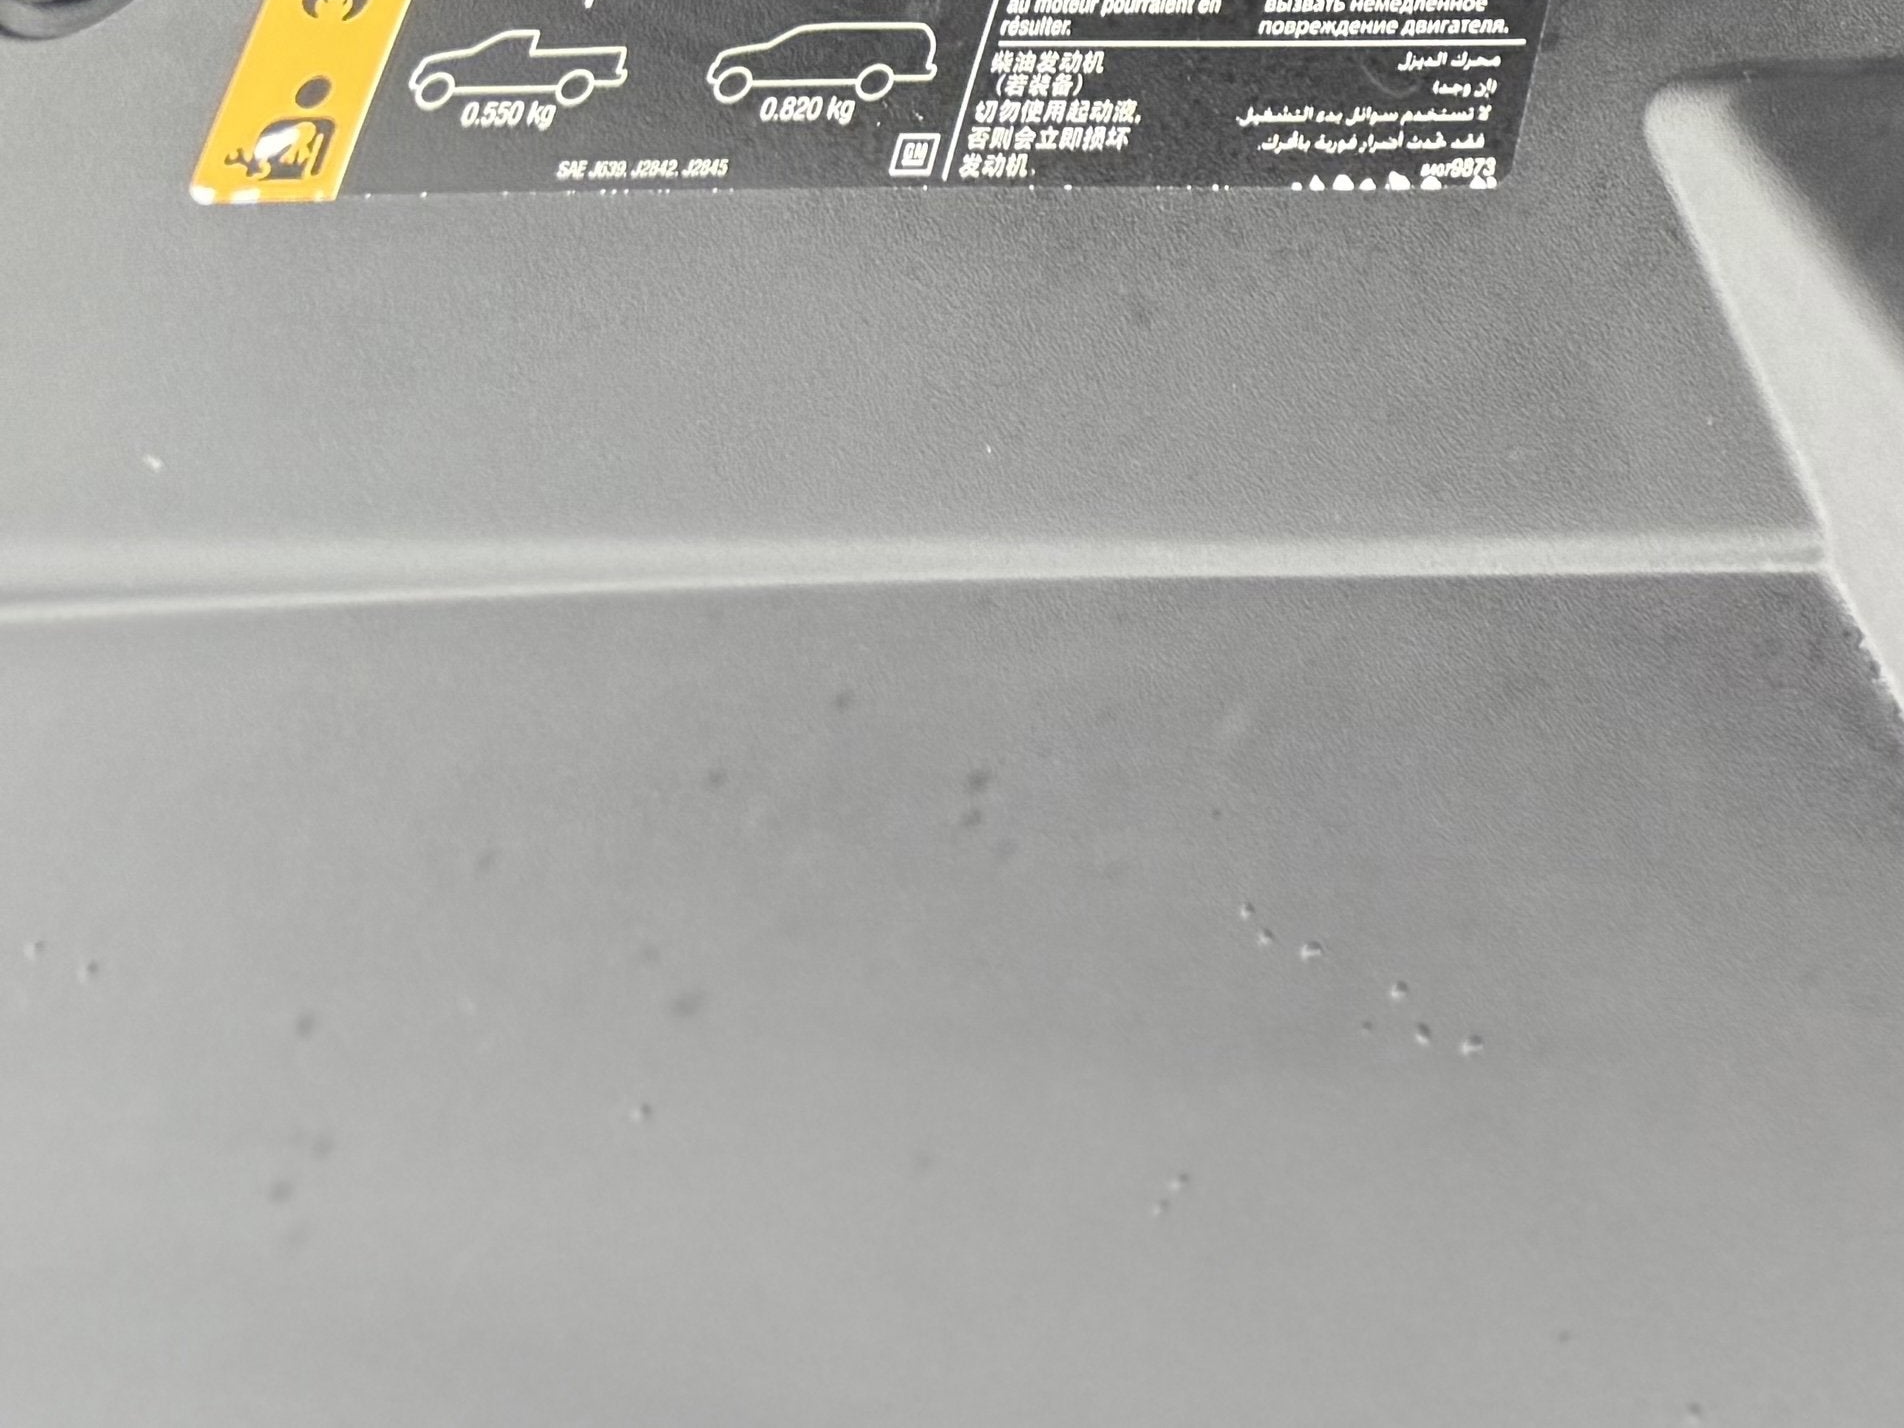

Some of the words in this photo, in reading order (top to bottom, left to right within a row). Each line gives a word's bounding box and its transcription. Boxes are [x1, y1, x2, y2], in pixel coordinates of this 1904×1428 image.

[1000, 16, 1072, 37] résulter.
[1258, 19, 1399, 38] повреждение
[1401, 19, 1509, 36] двигателя.
[990, 50, 1105, 74] 柴油发动机
[460, 101, 527, 127] 0.550
[528, 100, 557, 130] kg
[760, 97, 823, 122] 0.820
[826, 97, 855, 125] kg
[967, 126, 1132, 151] 否则会立即损坏
[556, 160, 587, 178] SAE
